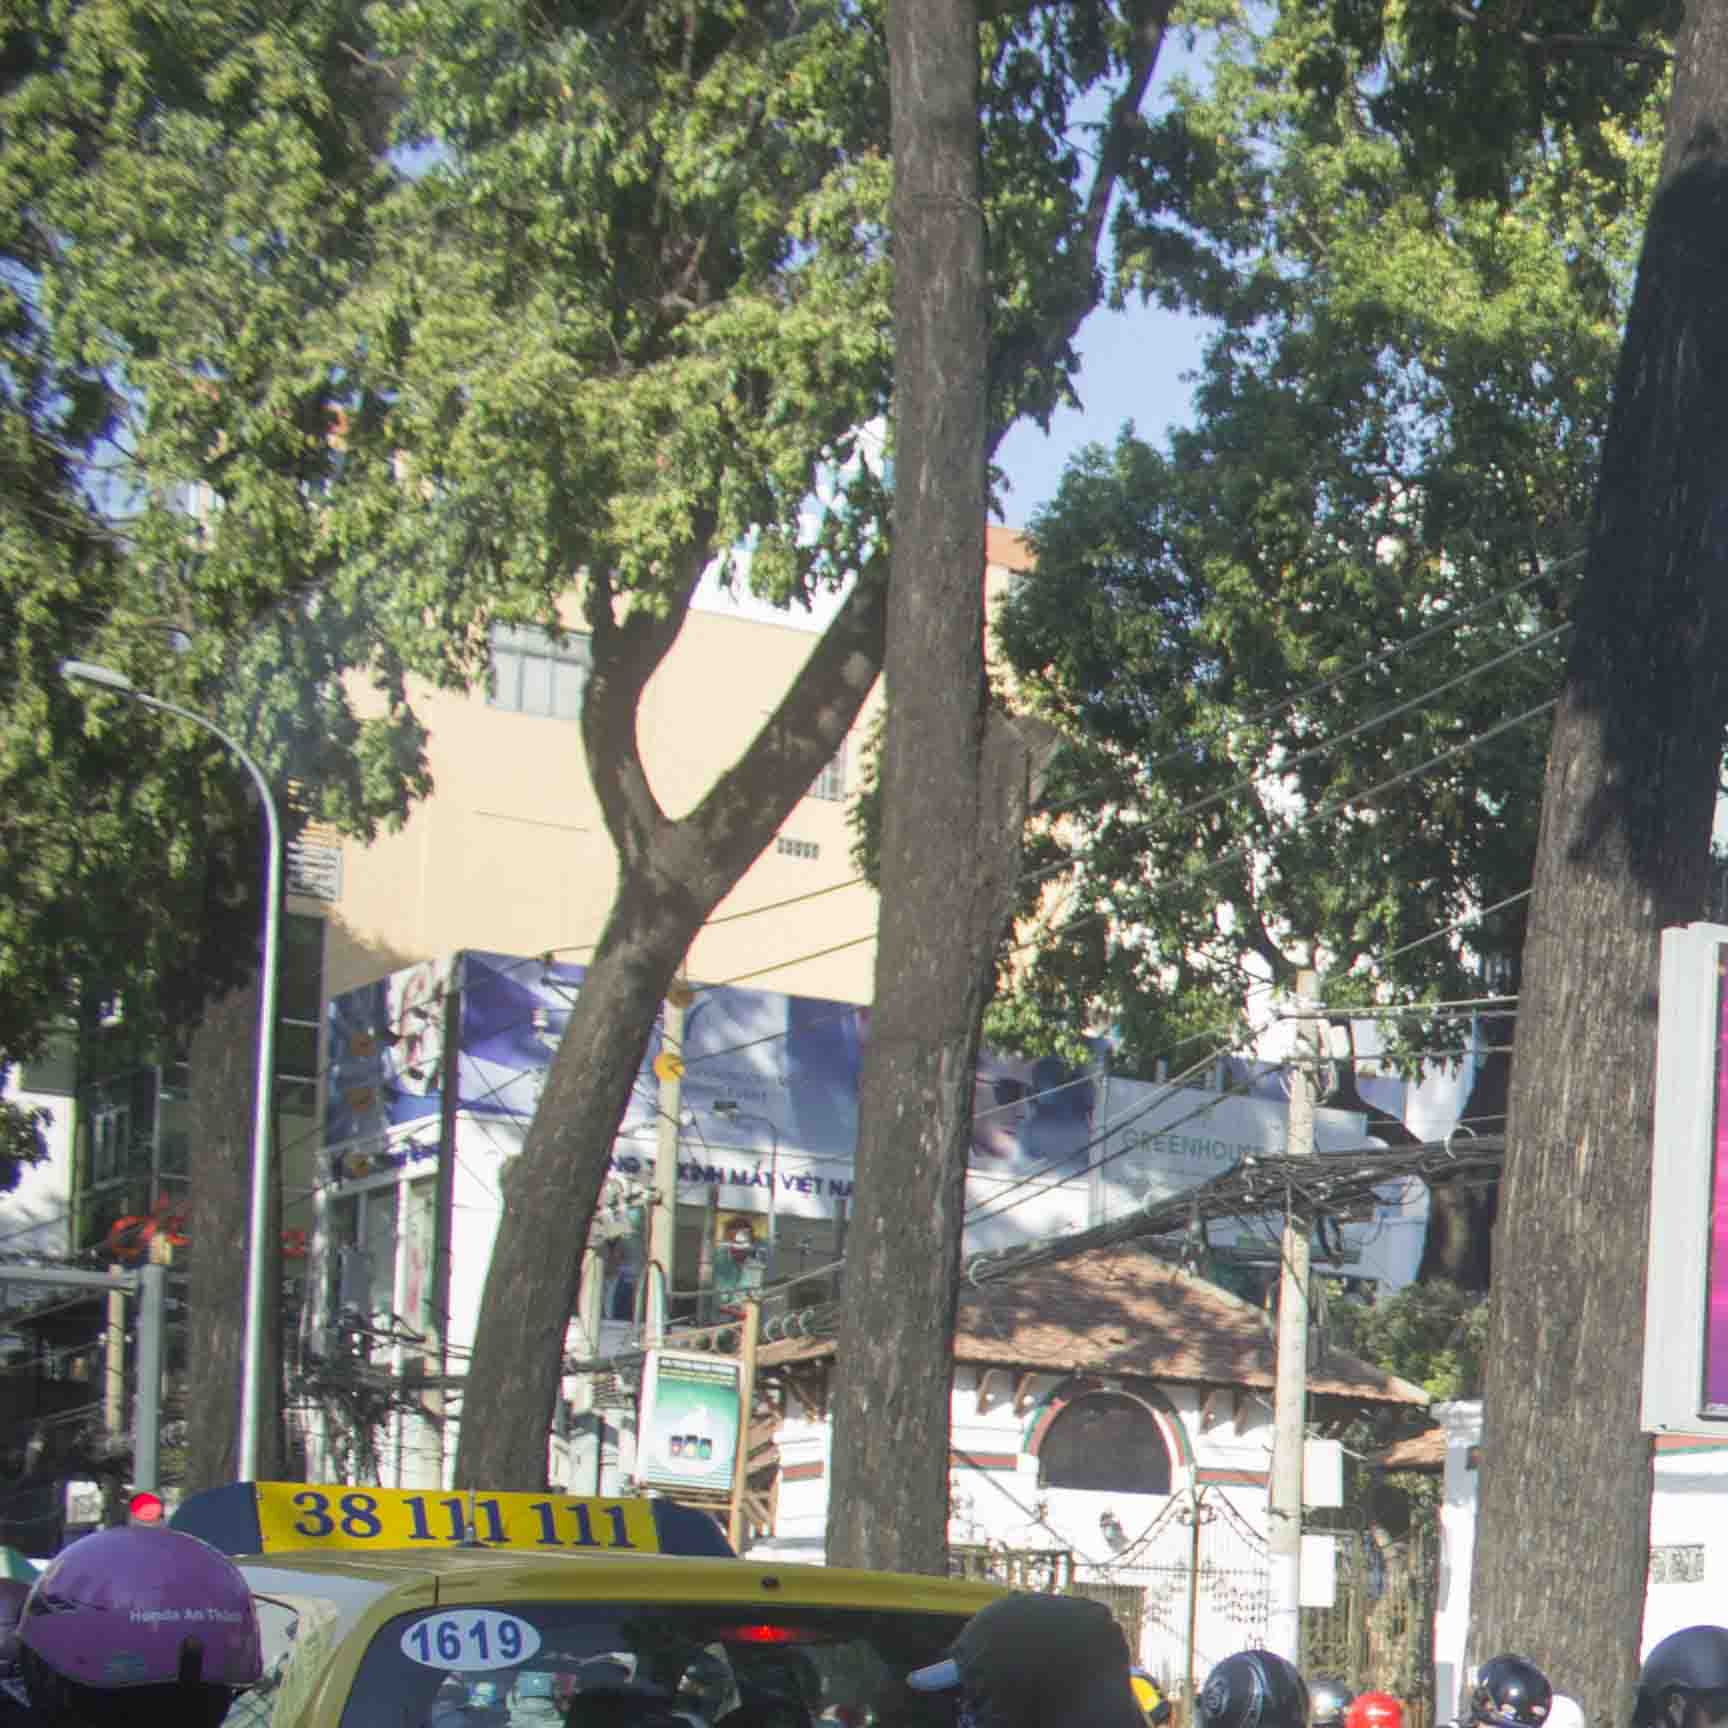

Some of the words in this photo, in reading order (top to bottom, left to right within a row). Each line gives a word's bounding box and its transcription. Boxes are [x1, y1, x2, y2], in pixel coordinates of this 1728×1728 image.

[293, 1490, 384, 1538] 38
[402, 1496, 512, 1544] 111
[530, 1501, 641, 1548] 111
[410, 1621, 524, 1666] 1619
